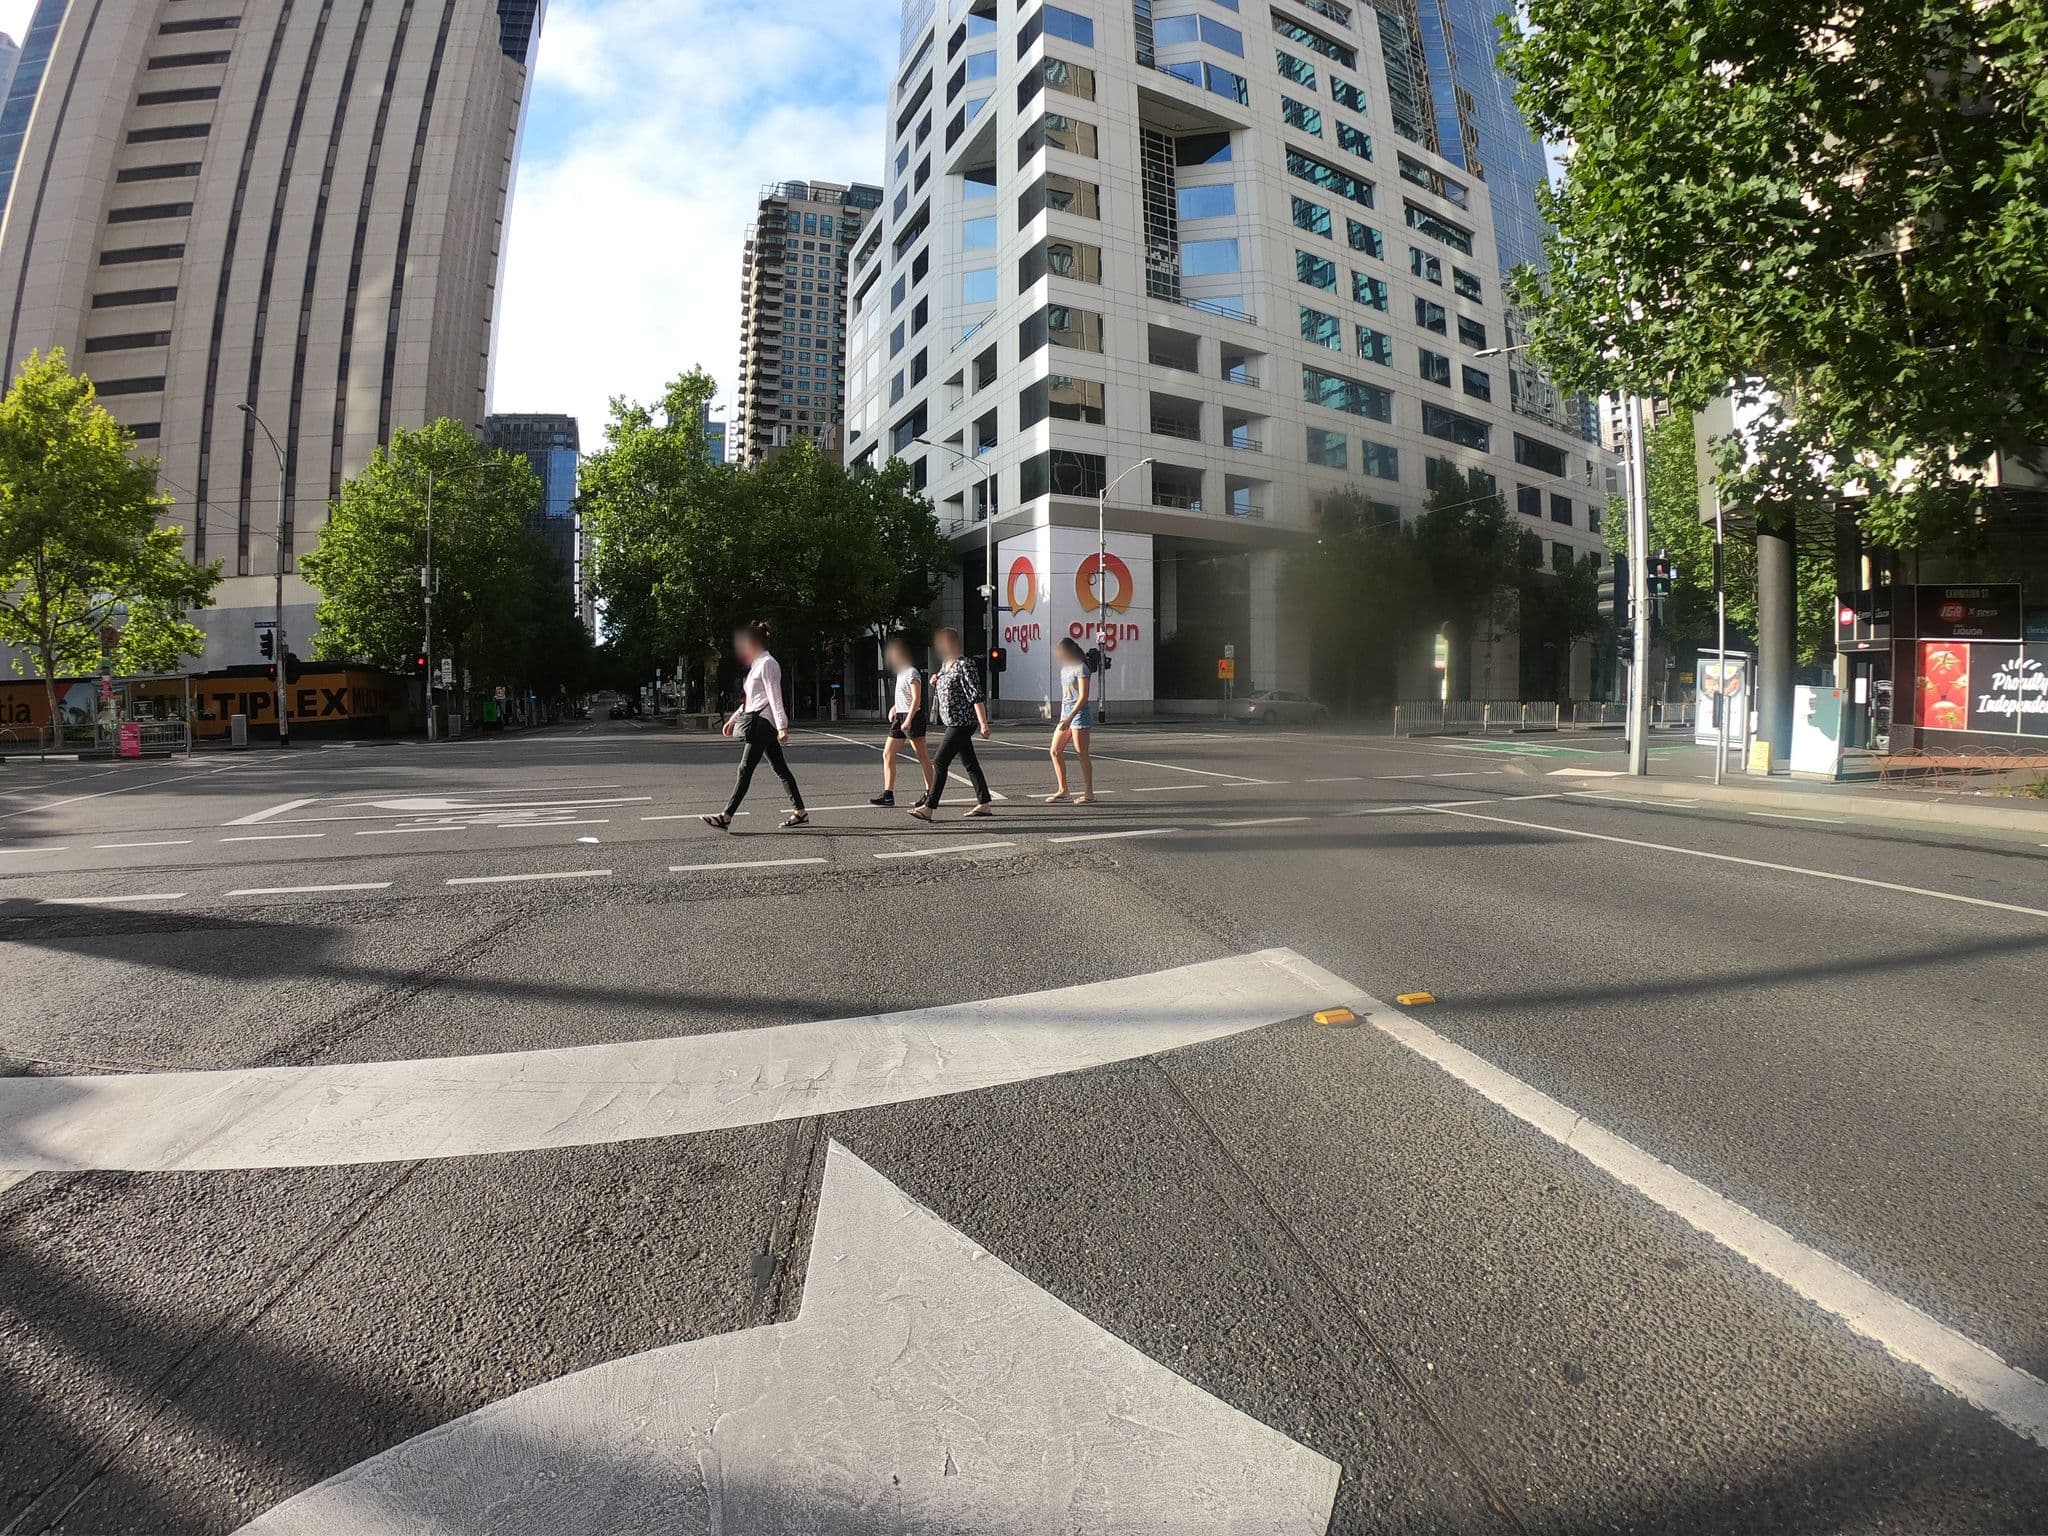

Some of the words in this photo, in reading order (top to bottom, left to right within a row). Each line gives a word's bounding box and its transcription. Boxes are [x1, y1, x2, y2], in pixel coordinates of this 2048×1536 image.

[1941, 606, 1963, 617] IGA
[1004, 623, 1041, 653] origin
[1069, 622, 1139, 652] origin
[1992, 672, 2048, 696] Proudly
[188, 688, 348, 721] LTIPLEX
